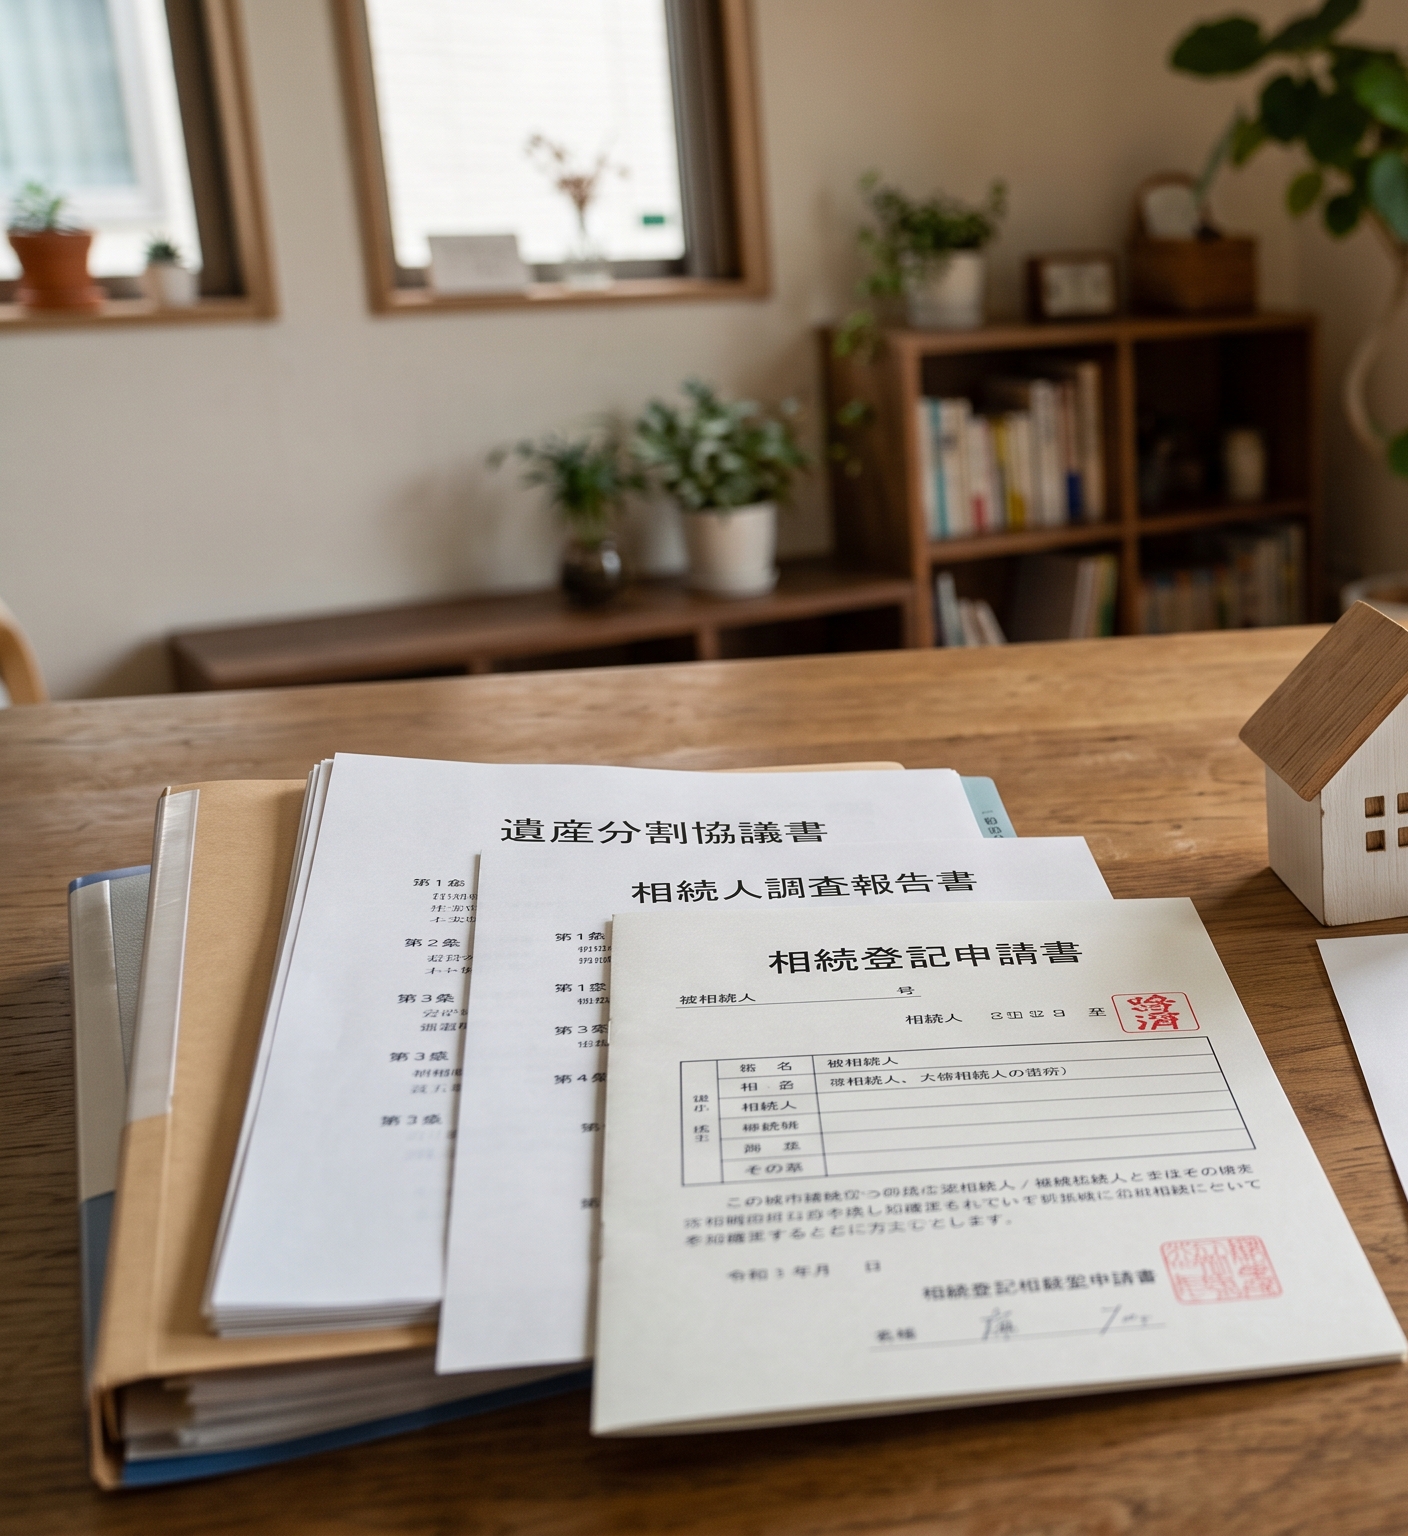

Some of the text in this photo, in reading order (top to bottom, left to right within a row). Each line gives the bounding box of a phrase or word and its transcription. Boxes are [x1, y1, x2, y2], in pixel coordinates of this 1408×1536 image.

[500, 817, 828, 845] 遺産分割協議書
[631, 870, 978, 904] 相続人調査報告書
[768, 940, 1083, 975] 相続登記申請書
[679, 992, 757, 1005] 被相続人
[905, 1013, 963, 1025] 相続人
[741, 1100, 797, 1112] 相続人
